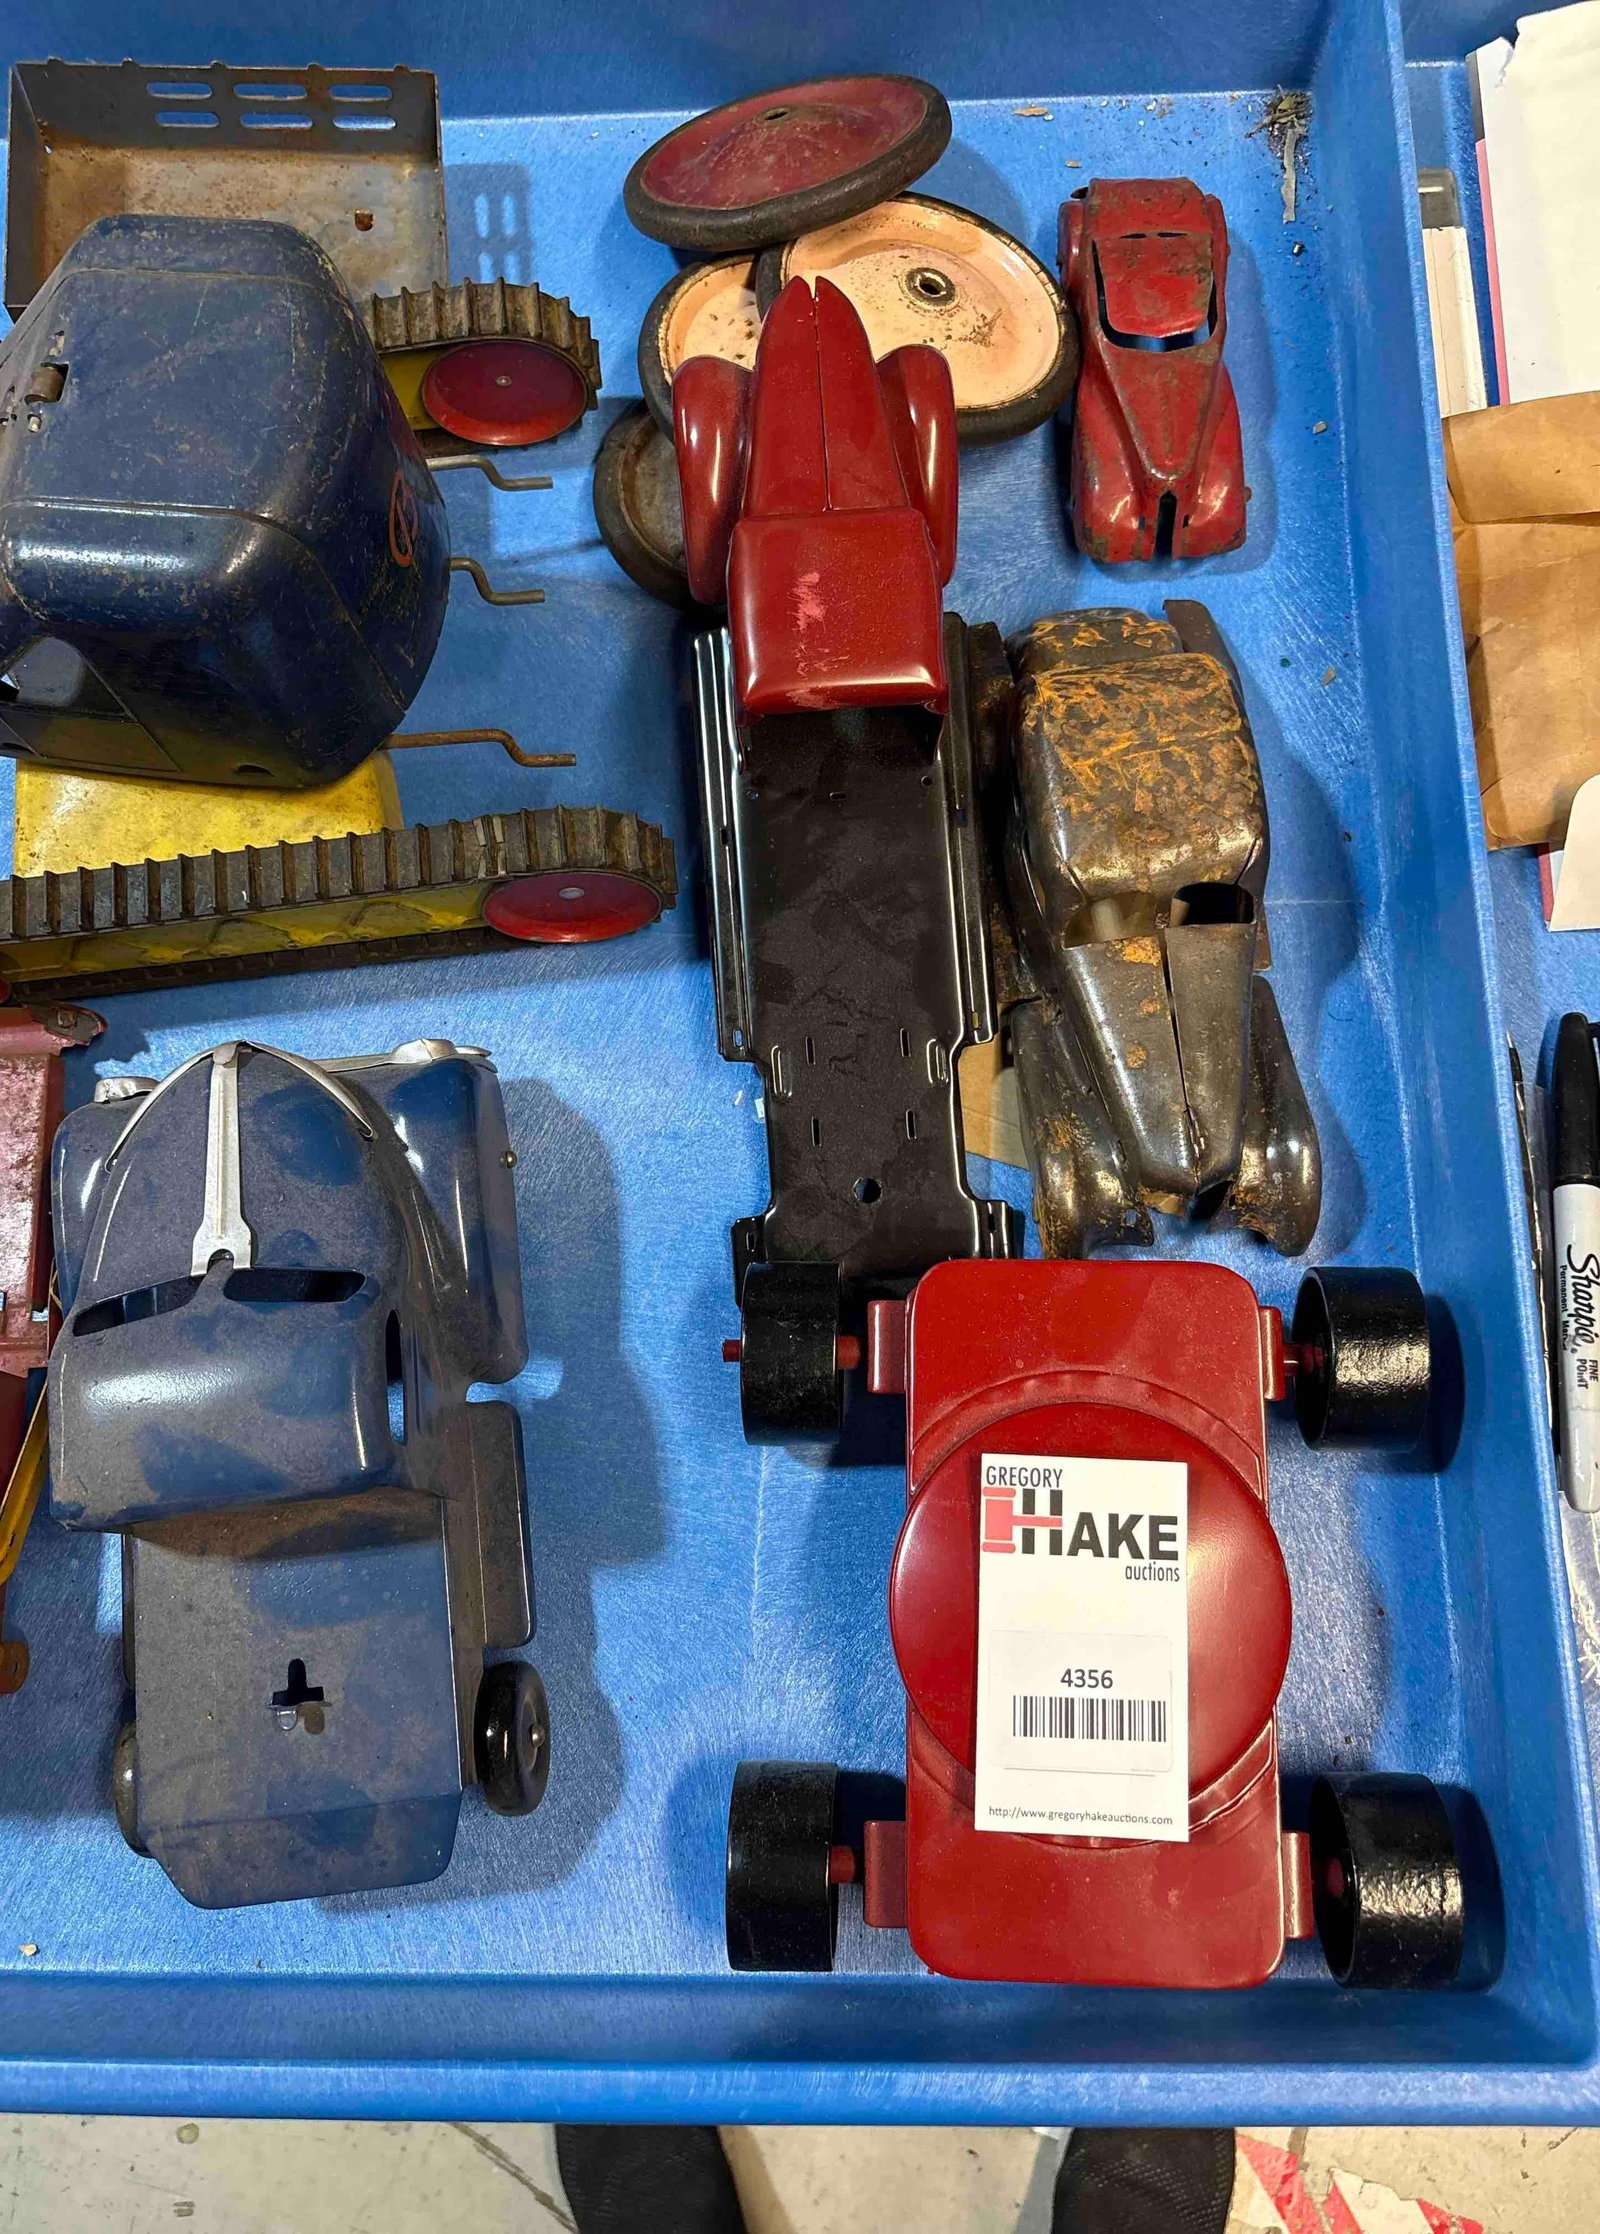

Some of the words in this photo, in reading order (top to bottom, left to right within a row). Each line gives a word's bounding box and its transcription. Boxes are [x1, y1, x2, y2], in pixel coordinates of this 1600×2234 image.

[1559, 1265, 1568, 1312] Permanent
[1566, 1243, 1600, 1348] Sharpie
[1576, 1357, 1588, 1389] POINT
[1588, 1359, 1598, 1382] FINE
[986, 1466, 1063, 1488] GREGORY
[1020, 1488, 1179, 1561] HAKE
[1125, 1561, 1180, 1582] auctions
[1060, 1668, 1113, 1689] 4356
[988, 1805, 1174, 1825] http://www.gregoryhakeauctions.com
